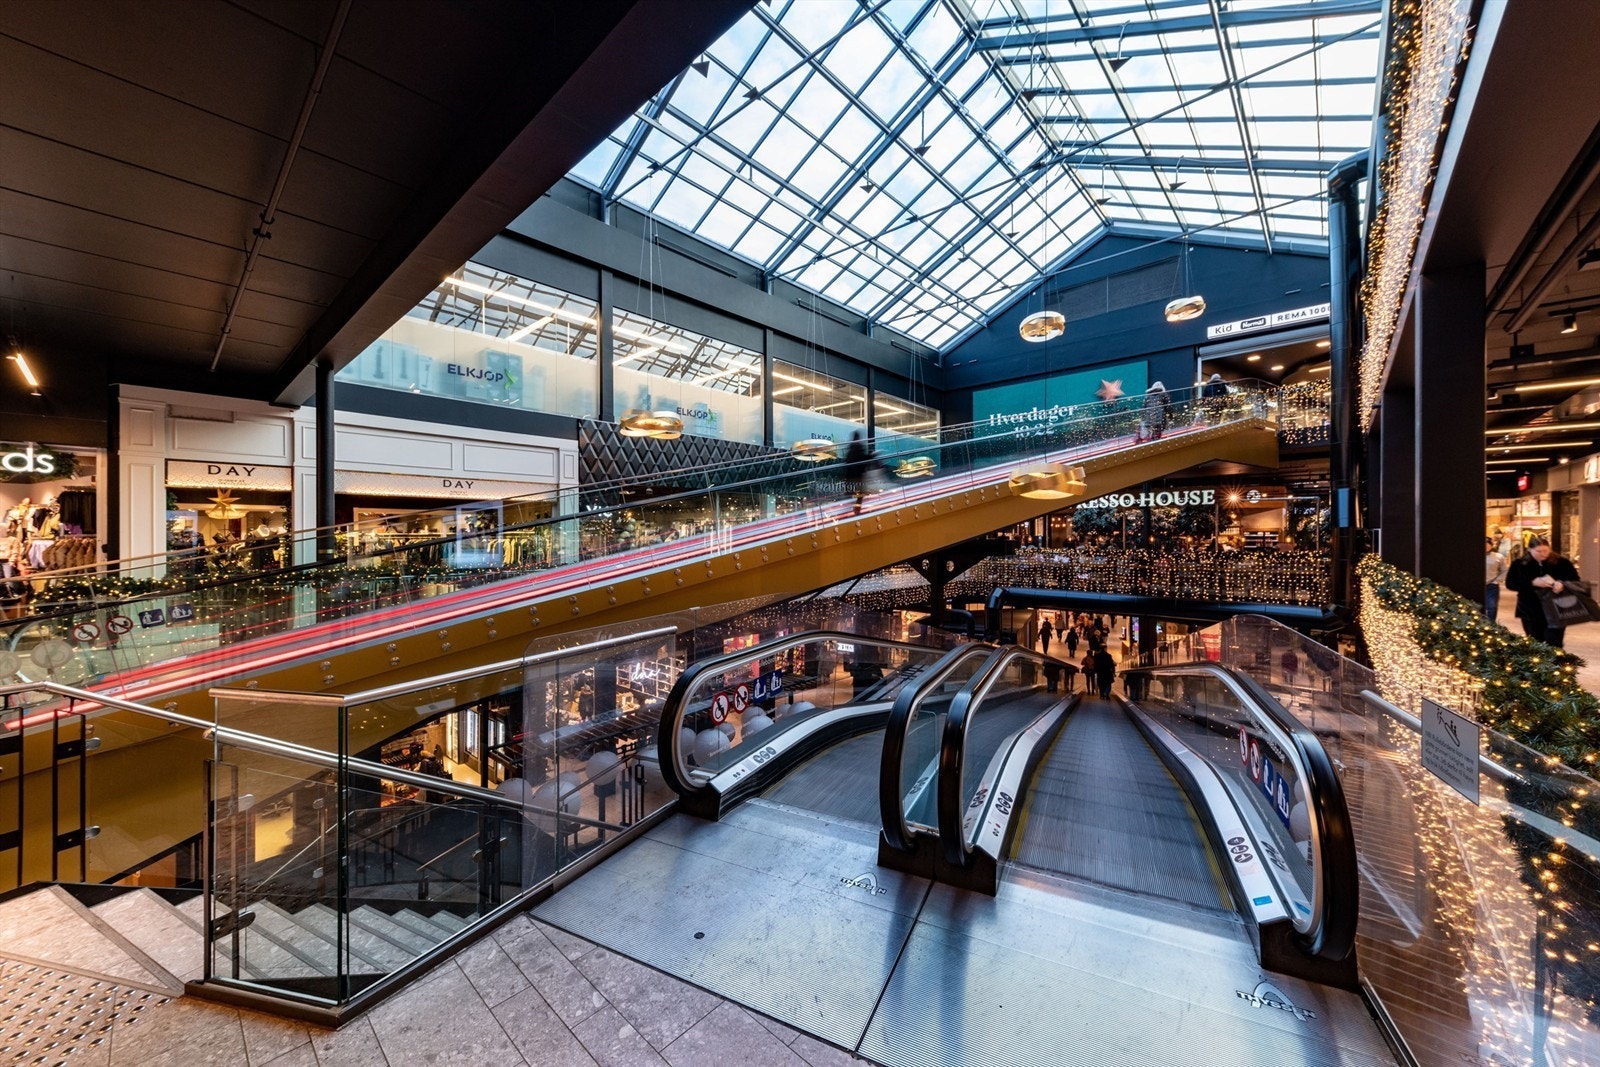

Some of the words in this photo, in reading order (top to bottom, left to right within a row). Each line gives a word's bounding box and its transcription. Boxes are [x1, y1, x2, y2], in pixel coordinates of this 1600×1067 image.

[1215, 324, 1233, 334] Kid
[1277, 311, 1306, 322] REMA
[989, 404, 1079, 427] Hverdager
[2, 447, 55, 474] ds
[207, 464, 256, 477] DAY
[442, 479, 474, 489] DAY
[1138, 489, 1216, 508] HOUSE
[1235, 989, 1317, 1020] THYSSN
